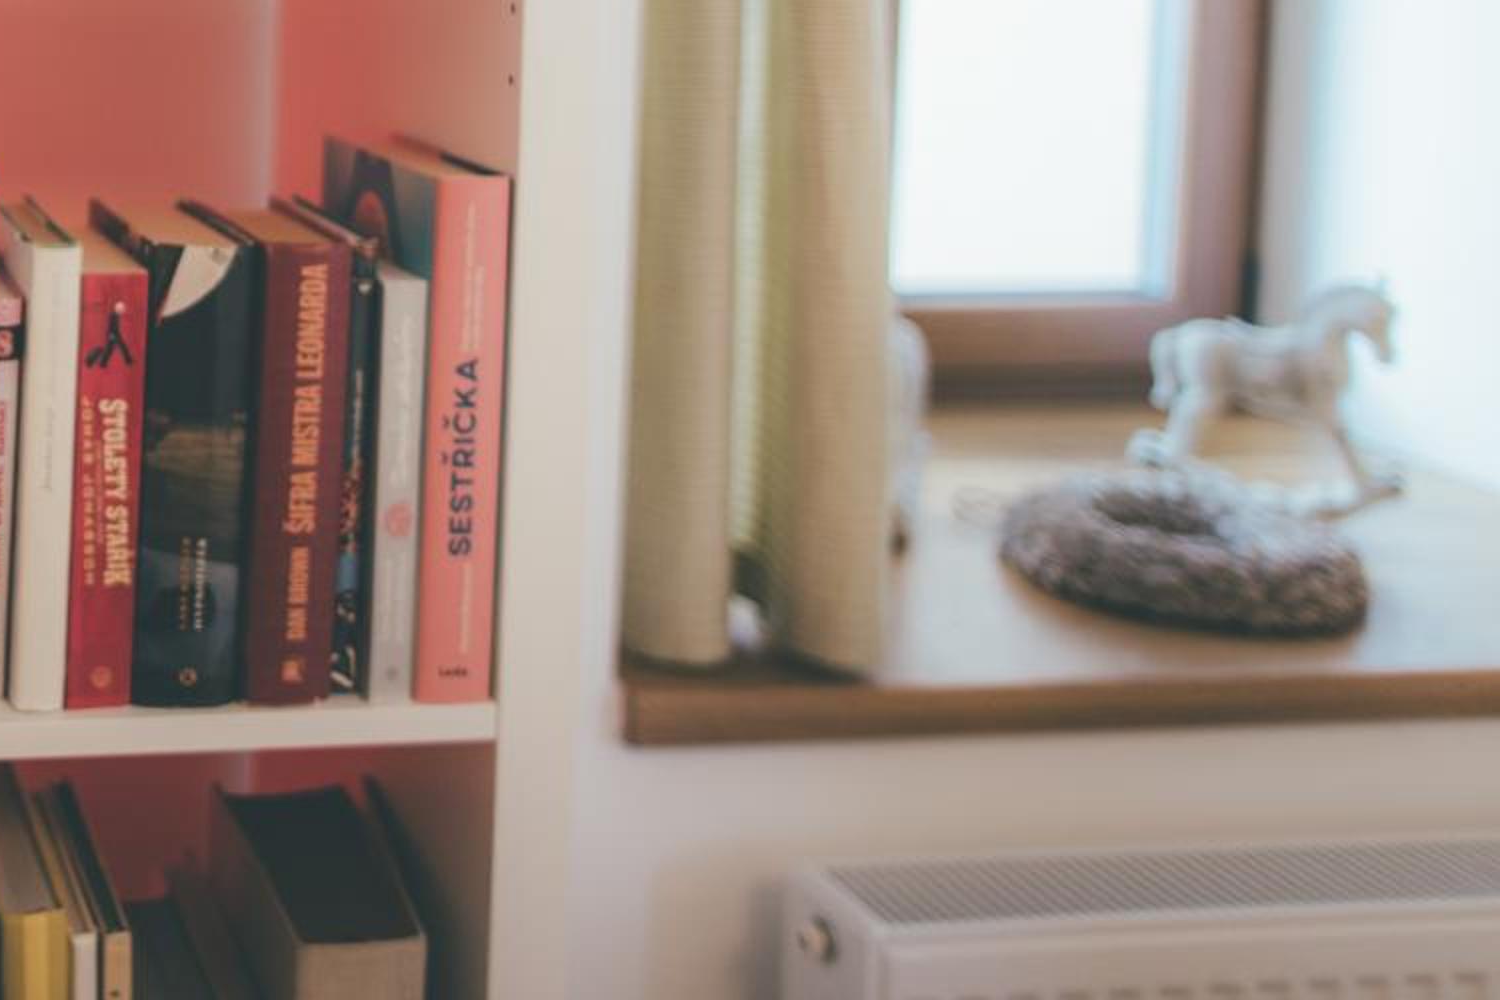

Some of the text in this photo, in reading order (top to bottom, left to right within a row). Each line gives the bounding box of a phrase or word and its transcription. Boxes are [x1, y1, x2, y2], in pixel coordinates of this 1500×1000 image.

[284, 263, 329, 534] ŠIFRA MISTRA LEONARDA
[441, 357, 479, 558] SESTŘIČKA
[287, 546, 309, 641] DAN BROWN
